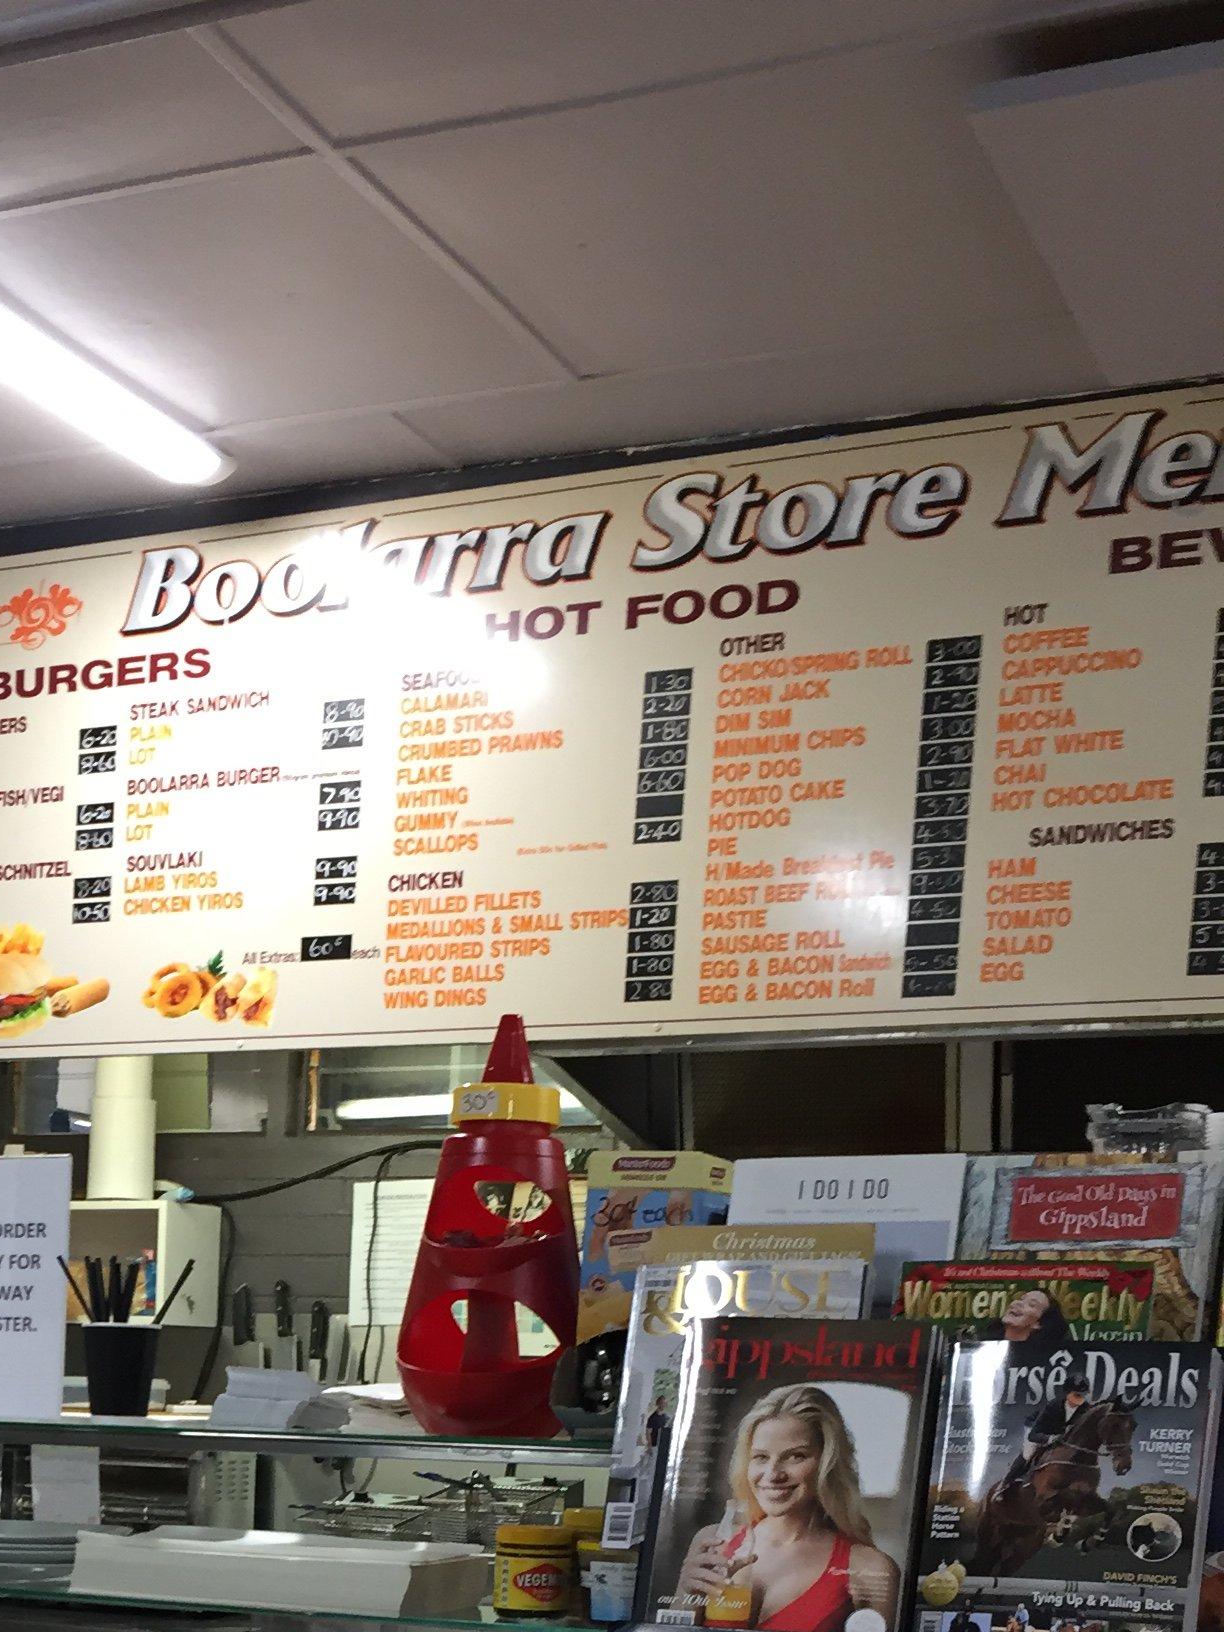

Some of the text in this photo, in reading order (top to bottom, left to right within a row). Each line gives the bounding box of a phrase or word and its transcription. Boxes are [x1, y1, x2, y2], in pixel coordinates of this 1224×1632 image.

[630, 462, 972, 572] Store
[995, 408, 1224, 527] Me
[485, 579, 801, 642] HOT FOOD
[1003, 603, 1049, 626] HOT
[719, 632, 787, 657] OTHER
[1002, 626, 1090, 654] COFFEE
[865, 645, 913, 668] ROLL
[1001, 647, 1144, 681] CAPPUCCINO
[401, 690, 488, 715] CALAMARI
[717, 678, 831, 708] CORN JACK
[999, 682, 1064, 707] LATTE
[130, 690, 270, 721] STEAK SANDWICH
[399, 711, 514, 738] CRAB STICKS
[715, 708, 792, 733] DIM SIM
[997, 708, 1076, 733] MOCHA
[398, 729, 564, 762] CRUMBED PRAWNS
[714, 726, 866, 758] MINIMUM CHIPS
[995, 729, 1125, 759] FLAT WHITE
[127, 773, 210, 796] BOOLARRA
[217, 766, 281, 787] BURGER
[397, 765, 452, 785] FLAKE
[712, 758, 802, 783] POP DOG
[993, 763, 1046, 785] CHAI
[396, 787, 469, 809] WHITING
[710, 779, 846, 809] POTATO CAKE
[991, 778, 1175, 811] HOT CHOCOLATE
[394, 811, 458, 832] GUMMY
[709, 807, 791, 831] HOTDOG
[393, 833, 478, 856] SCALLOPS
[1028, 818, 1176, 847] SANDWICHES
[707, 837, 738, 856] PIE
[126, 851, 204, 872] SOUVLAKI
[988, 857, 1037, 878] HAM
[124, 871, 218, 894] LAMB YIROS
[388, 870, 464, 892] CHICKEN
[986, 880, 1072, 904] CHEESE
[123, 892, 244, 916] CHICKEN YIROS
[387, 890, 542, 916] DEVILLED FILLETS
[704, 886, 759, 906] ROAST
[764, 882, 810, 903] BEEF
[386, 908, 628, 940] MEDALLIONS SMALL STRIPS
[703, 909, 768, 930] PASTIE
[986, 907, 1073, 930] TOMATO
[385, 937, 551, 963] FLAVOURED STRIPS
[701, 930, 845, 955] SAUSAGE ROLL
[982, 934, 1054, 957] SALAD
[384, 963, 505, 986] GARLIC BALLS
[700, 955, 834, 979] EGG BACON
[980, 961, 1024, 983] EGG
[384, 987, 487, 1009] WING DINGS
[698, 977, 875, 1004] EGG BACON Roll
[813, 1177, 890, 1200] DO DO
[1018, 1186, 1046, 1206] The
[1085, 1182, 1114, 1202] Old
[1038, 1205, 1148, 1234] Gippsland
[712, 1230, 817, 1251] Christmas
[9, 1254, 41, 1270] FOR
[1084, 1350, 1200, 1408] Deals
[1149, 1428, 1193, 1441] KERRY
[1138, 1441, 1191, 1453] TURNER
[1103, 1572, 1134, 1582] DAVID
[1032, 1591, 1174, 1612] Tying Up Pulling Back
